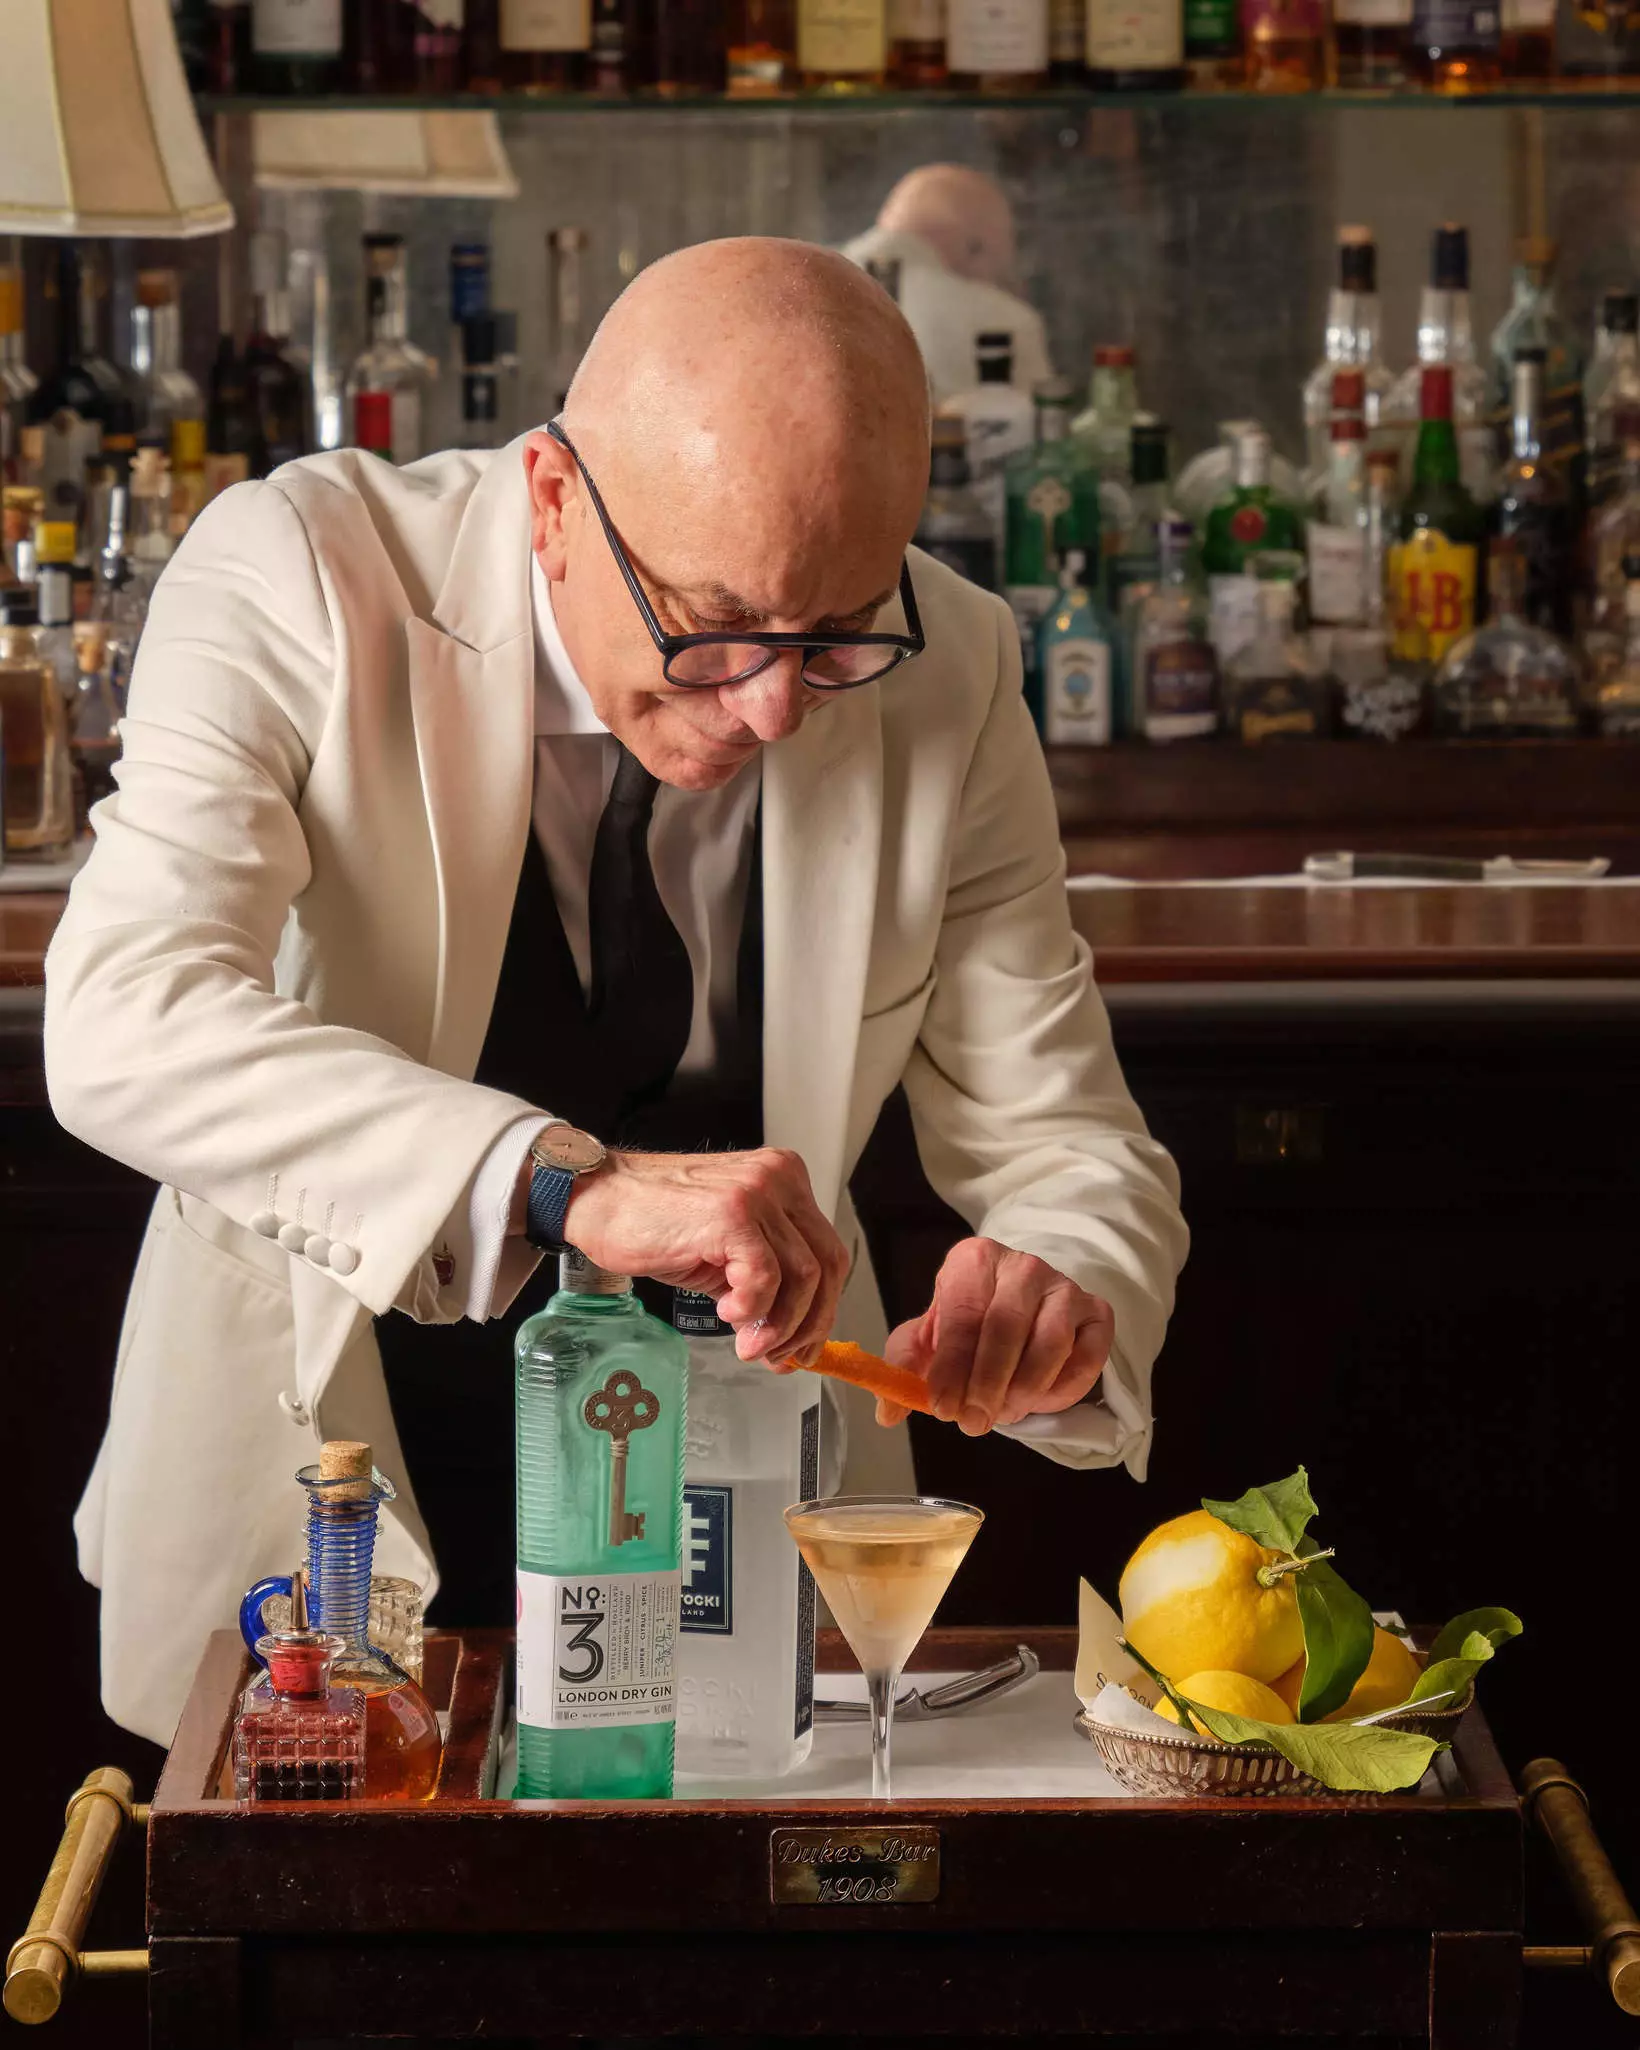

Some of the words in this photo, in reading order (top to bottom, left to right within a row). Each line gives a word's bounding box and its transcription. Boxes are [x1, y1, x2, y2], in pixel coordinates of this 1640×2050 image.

[681, 1594, 720, 1608] OCKI
[681, 1609, 705, 1617] LAND
[559, 1612, 605, 1684] 3
[559, 1690, 618, 1703] LONDON
[621, 1688, 648, 1701] DRY
[650, 1685, 673, 1698] GIN
[680, 1676, 759, 1700] OCKI
[778, 1837, 864, 1864] Dukes
[877, 1836, 936, 1863] Bar
[817, 1876, 897, 1902] 1908
